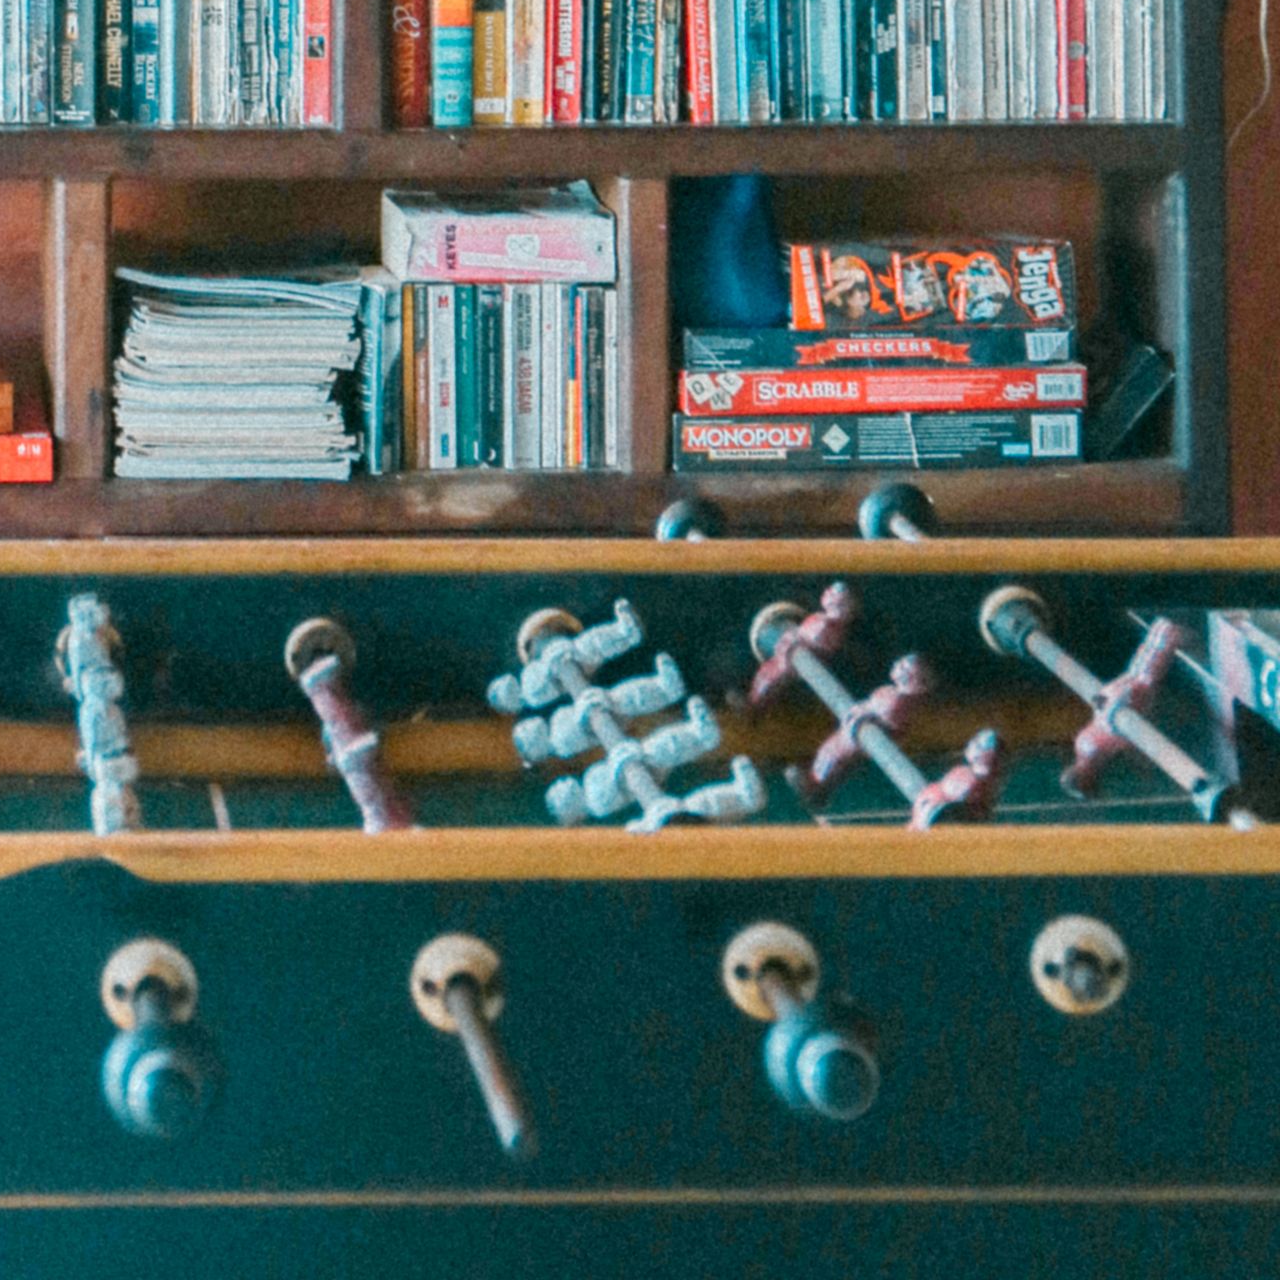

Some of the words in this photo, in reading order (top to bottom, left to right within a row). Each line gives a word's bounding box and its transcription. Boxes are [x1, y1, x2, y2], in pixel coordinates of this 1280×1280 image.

[393, 5, 421, 38] &
[483, 15, 494, 48] DAVID
[73, 62, 84, 86] NEAL
[105, 28, 122, 88] CONNELLY
[483, 49, 494, 93] TALBOT
[446, 224, 457, 271] KEYES
[1017, 249, 1063, 320] Jenga
[836, 340, 931, 354] CHECKERS
[517, 380, 532, 415] DAGAR
[758, 380, 859, 401] SCRABBLE
[687, 426, 807, 448] MONOPOLY
